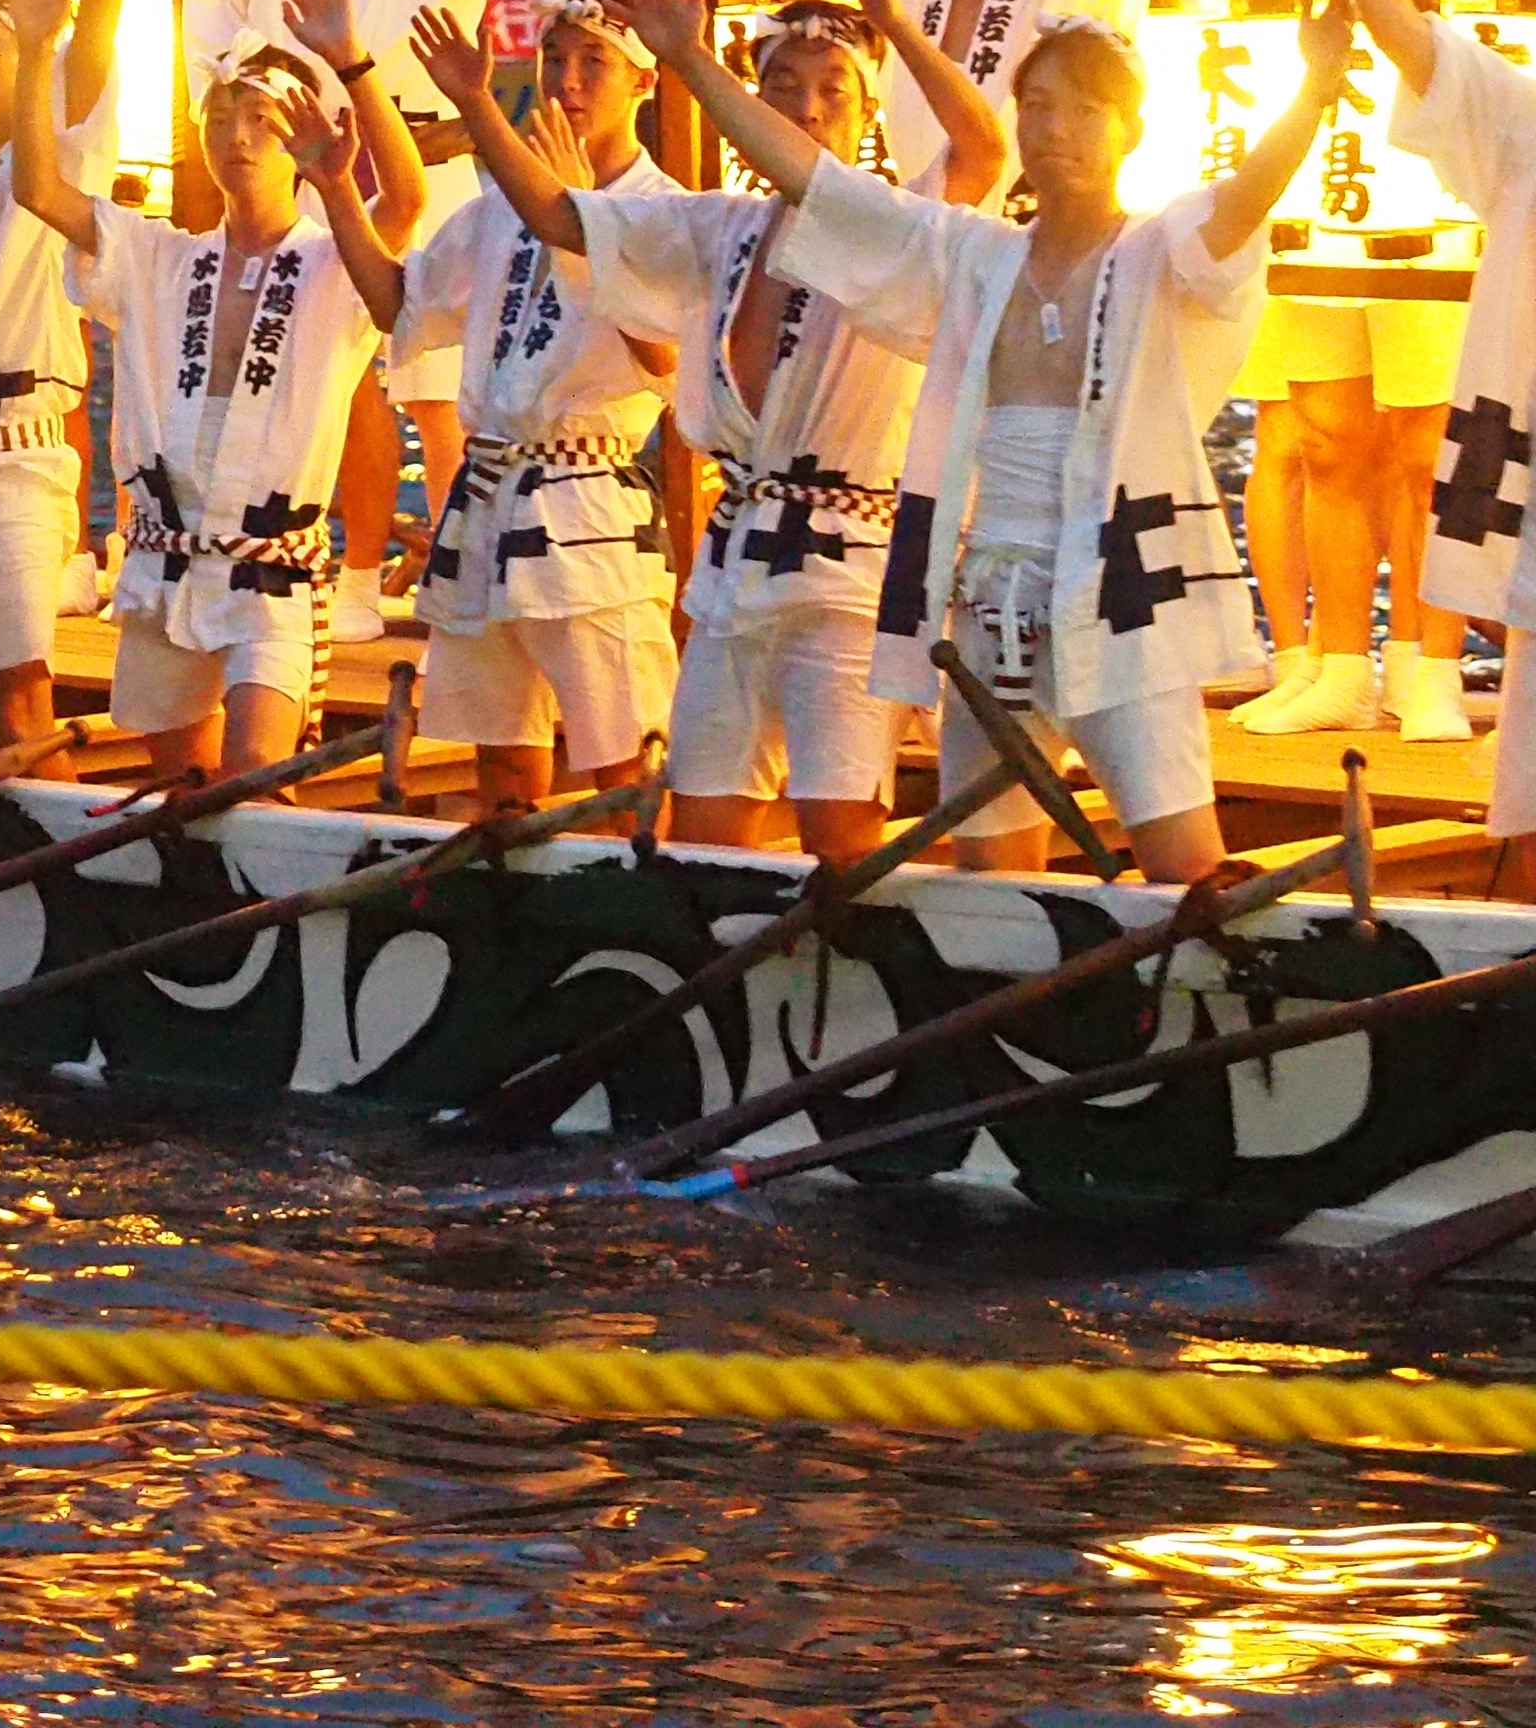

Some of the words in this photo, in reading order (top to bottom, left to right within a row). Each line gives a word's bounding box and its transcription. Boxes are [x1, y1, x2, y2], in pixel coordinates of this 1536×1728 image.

[177, 249, 220, 399] 木場若中
[245, 248, 304, 396] 木場若中
